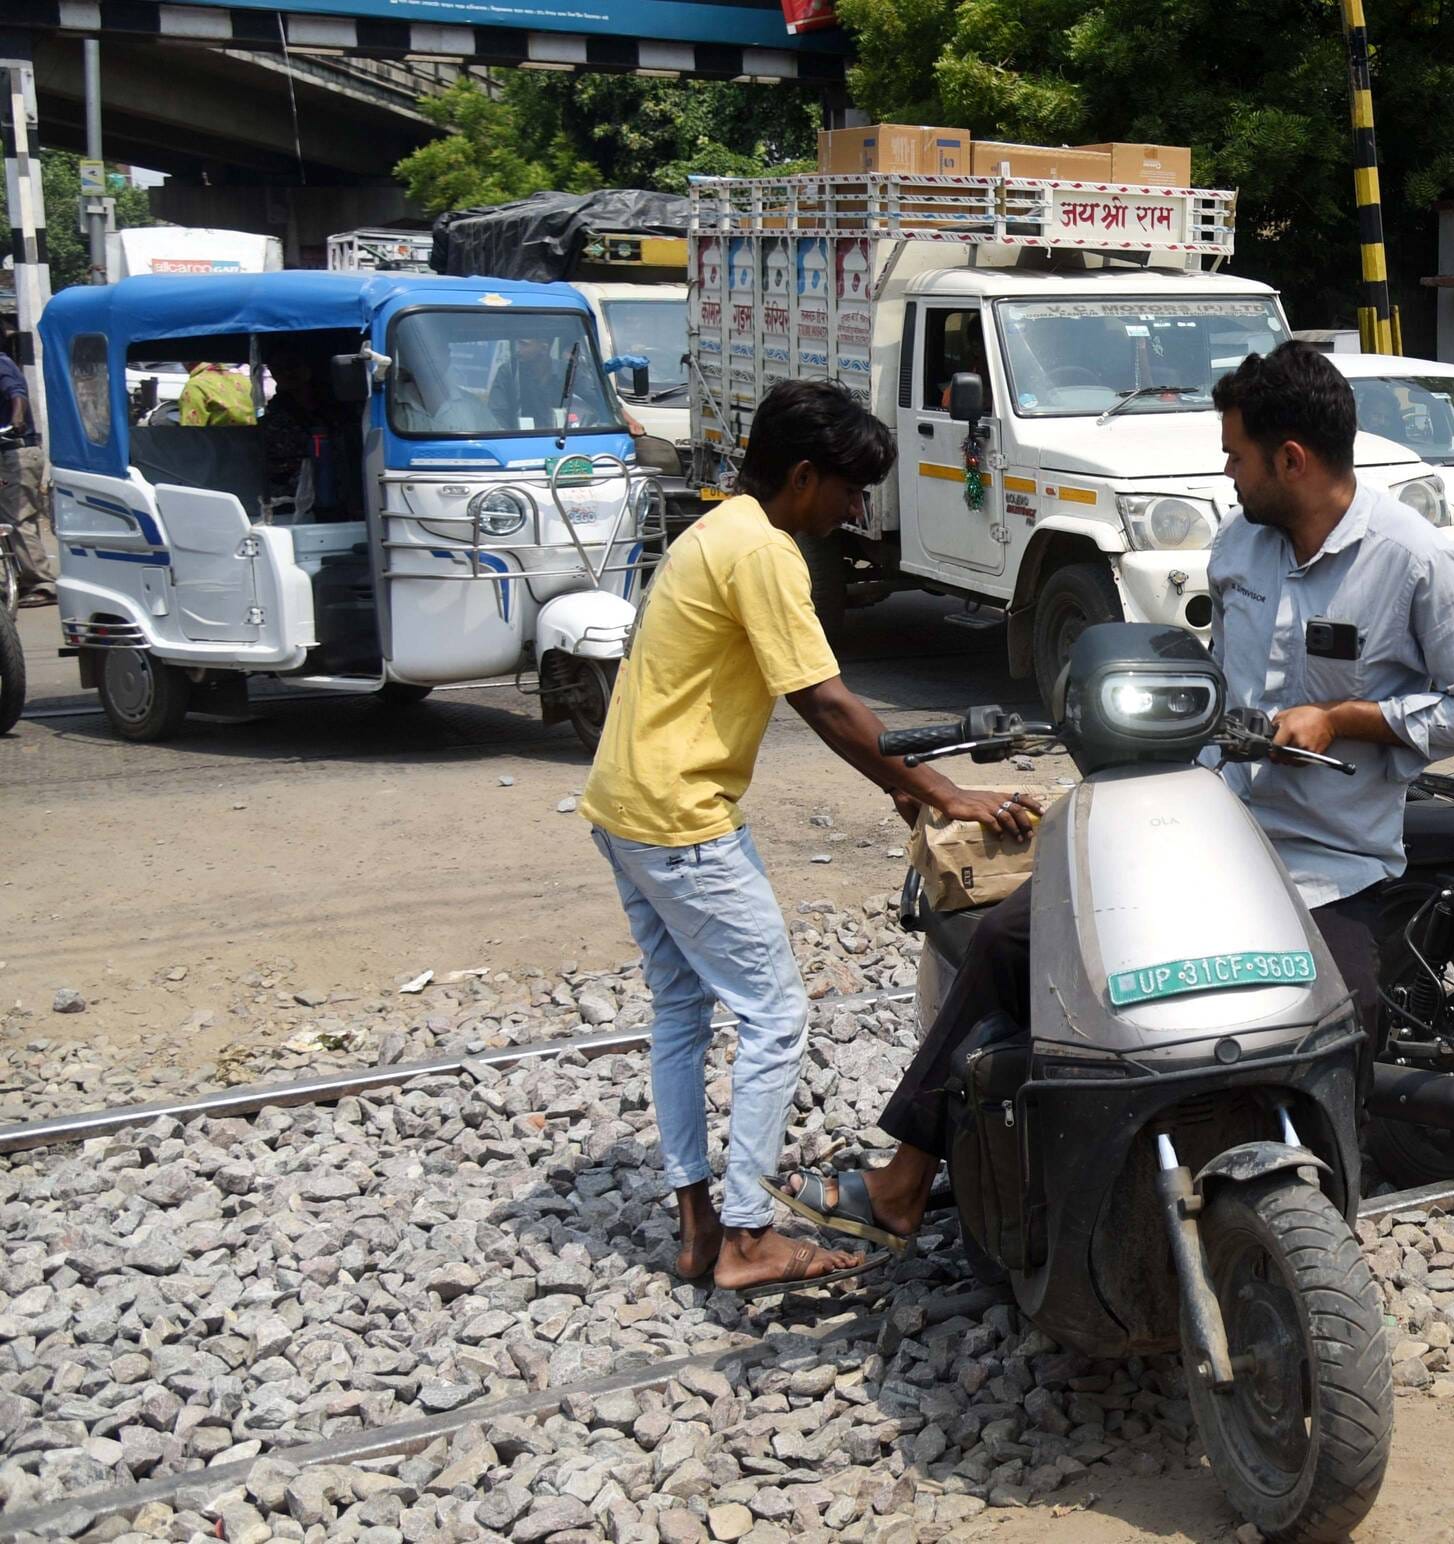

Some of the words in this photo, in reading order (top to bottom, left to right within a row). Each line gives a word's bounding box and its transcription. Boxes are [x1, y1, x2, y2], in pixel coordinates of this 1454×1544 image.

[1059, 201, 1099, 227] जय
[1100, 196, 1128, 230] श्री
[1134, 206, 1174, 232] राम
[1101, 304, 1190, 313] MOTORS
[1138, 967, 1171, 994] UP
[1183, 956, 1243, 986] 31CF
[1257, 955, 1310, 978] 9603
